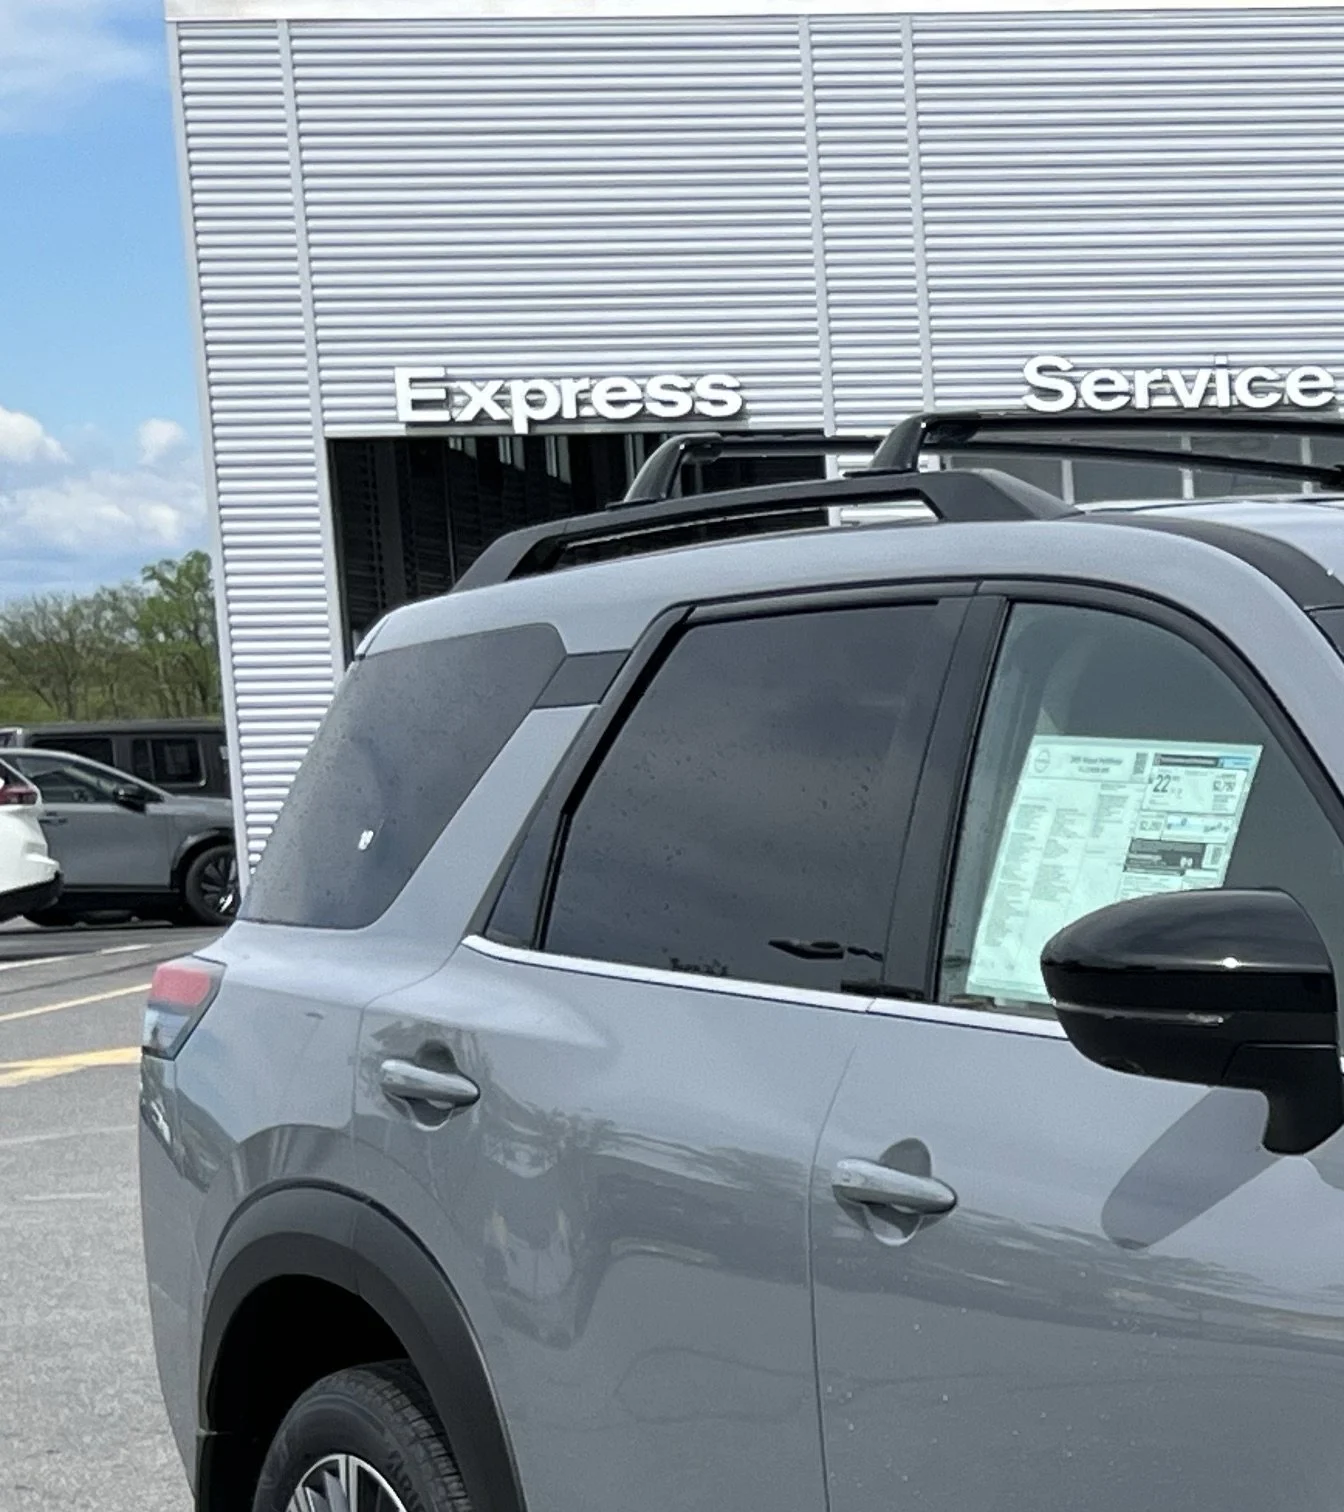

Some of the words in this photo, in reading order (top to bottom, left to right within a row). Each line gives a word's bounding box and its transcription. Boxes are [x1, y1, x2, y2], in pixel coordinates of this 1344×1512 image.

[395, 367, 744, 434] Express
[1022, 355, 1334, 413] Service
[1153, 774, 1172, 793] 22
